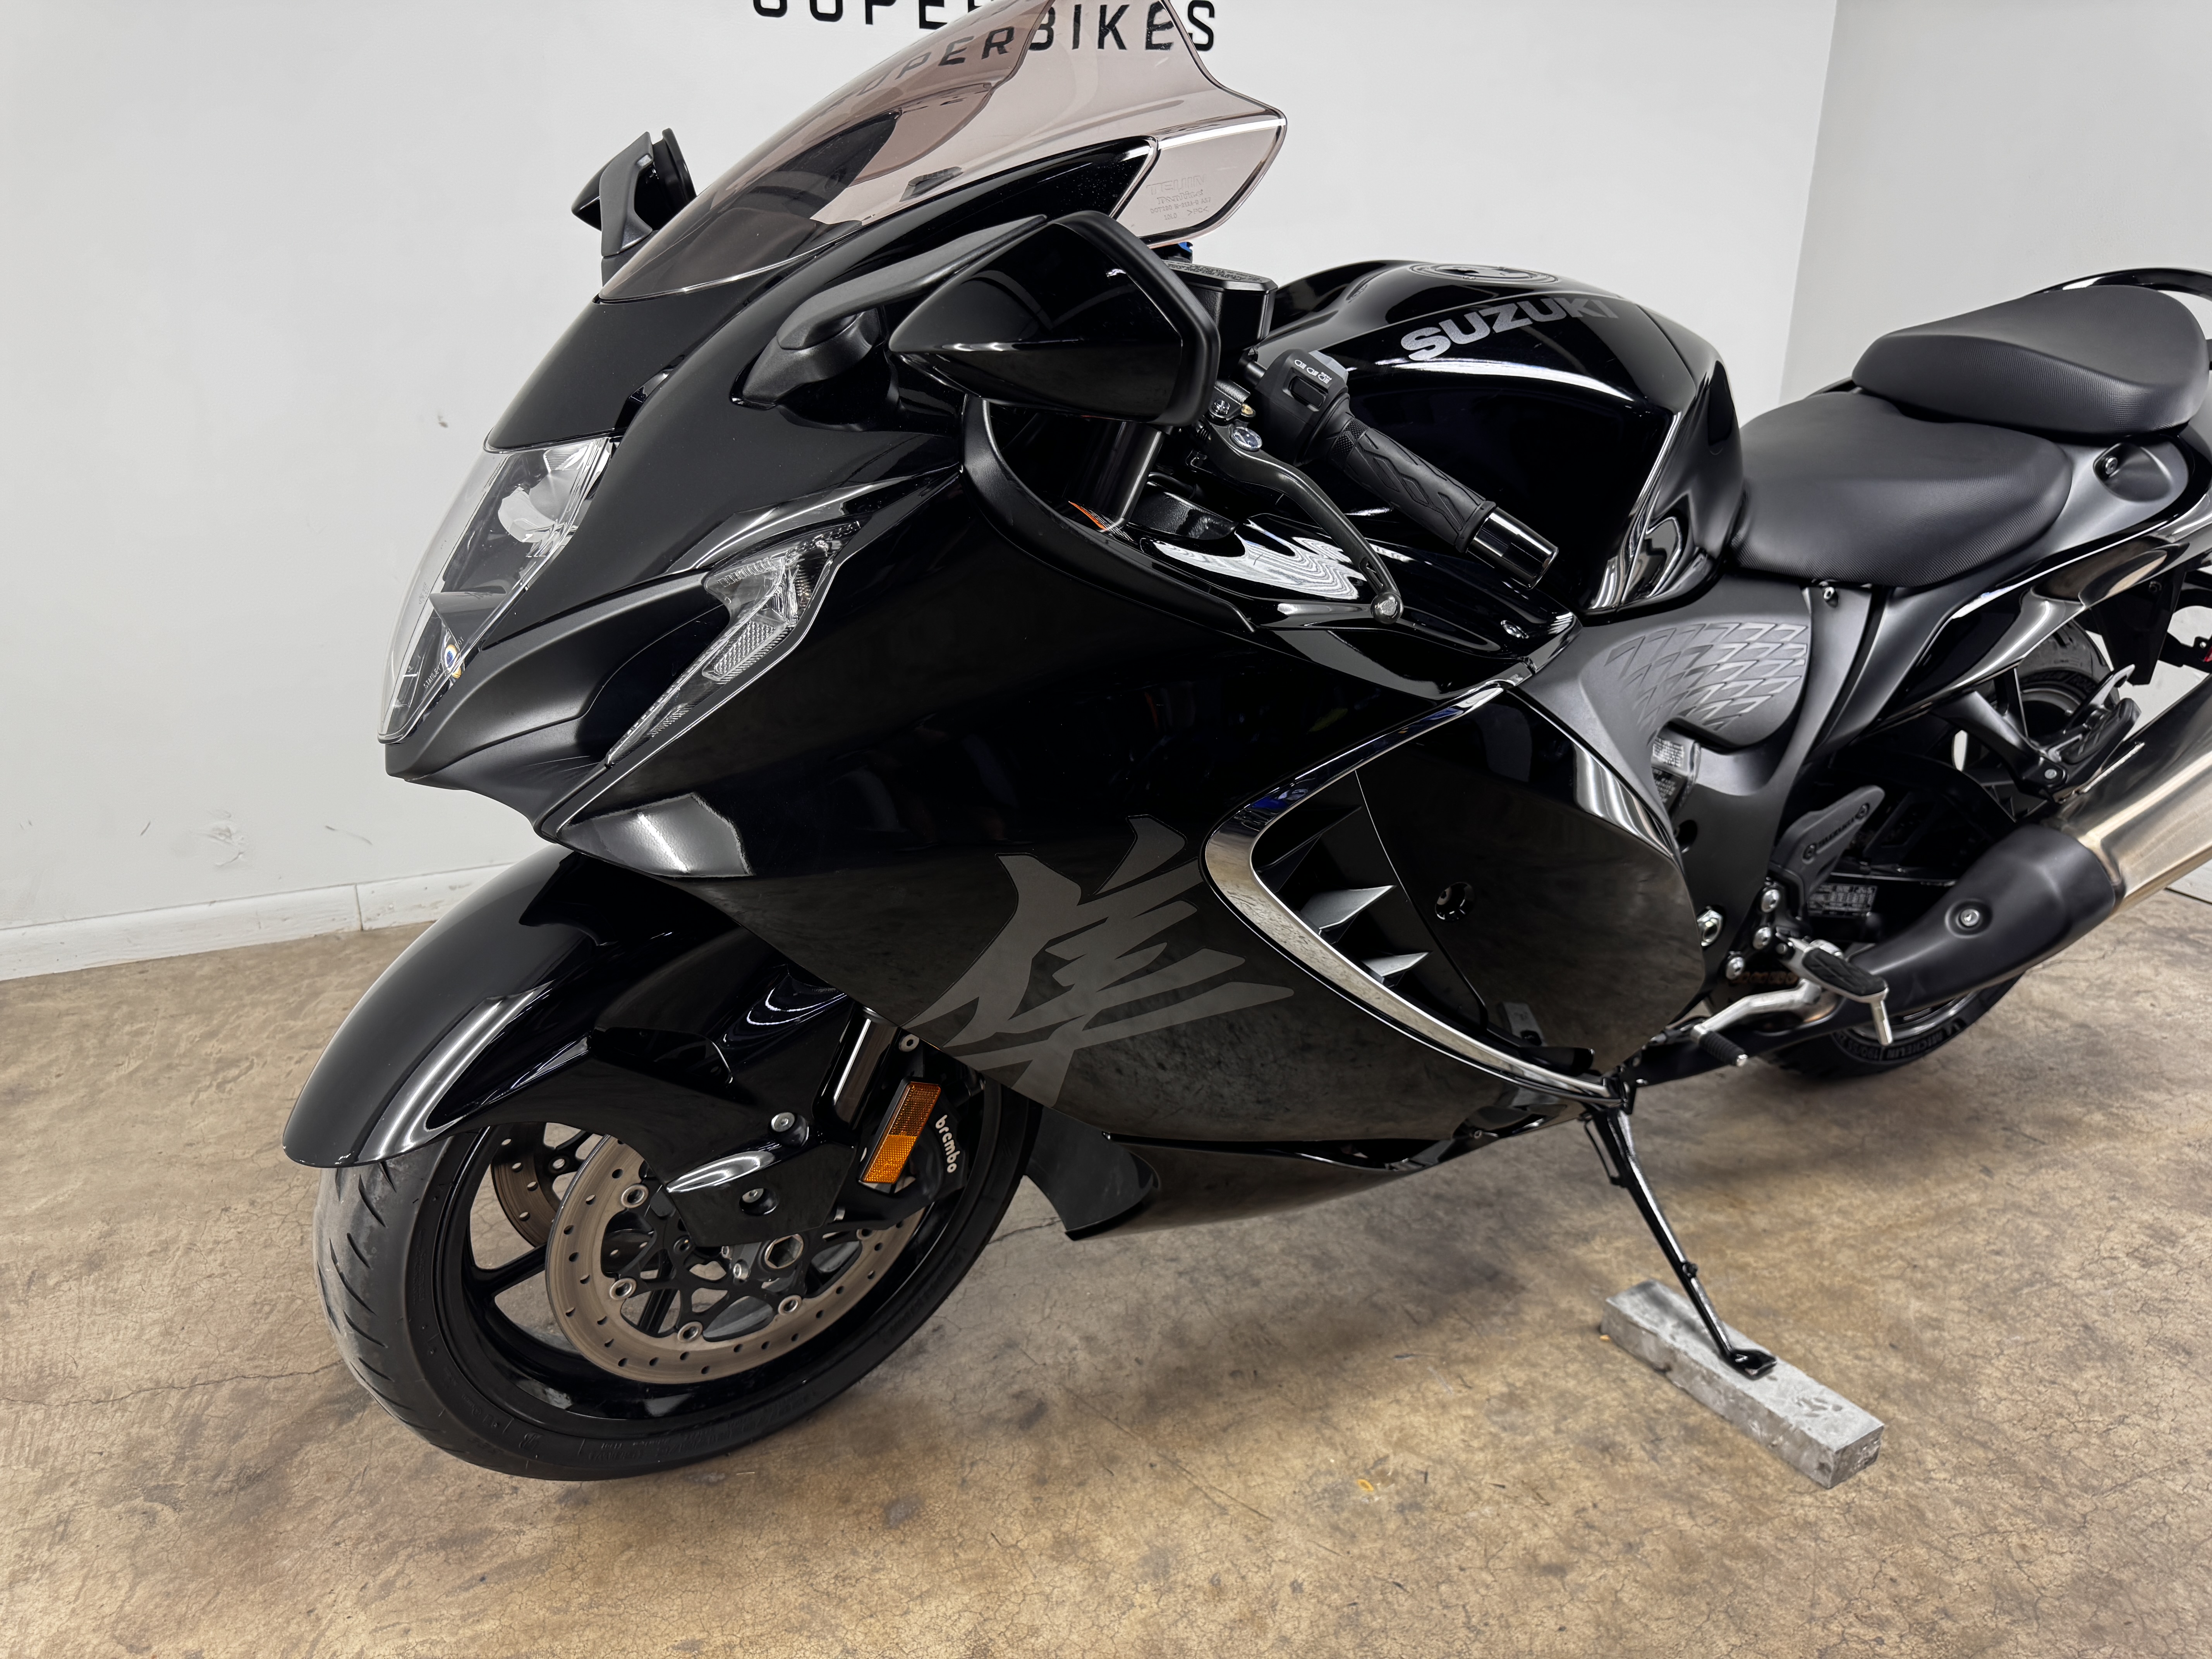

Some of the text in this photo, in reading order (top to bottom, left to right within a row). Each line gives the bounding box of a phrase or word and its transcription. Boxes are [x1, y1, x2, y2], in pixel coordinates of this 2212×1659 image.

[1400, 297, 1619, 361] SUZUKI
[1886, 1029, 1944, 1059] MICHELIN
[935, 1114, 960, 1173] brembo
